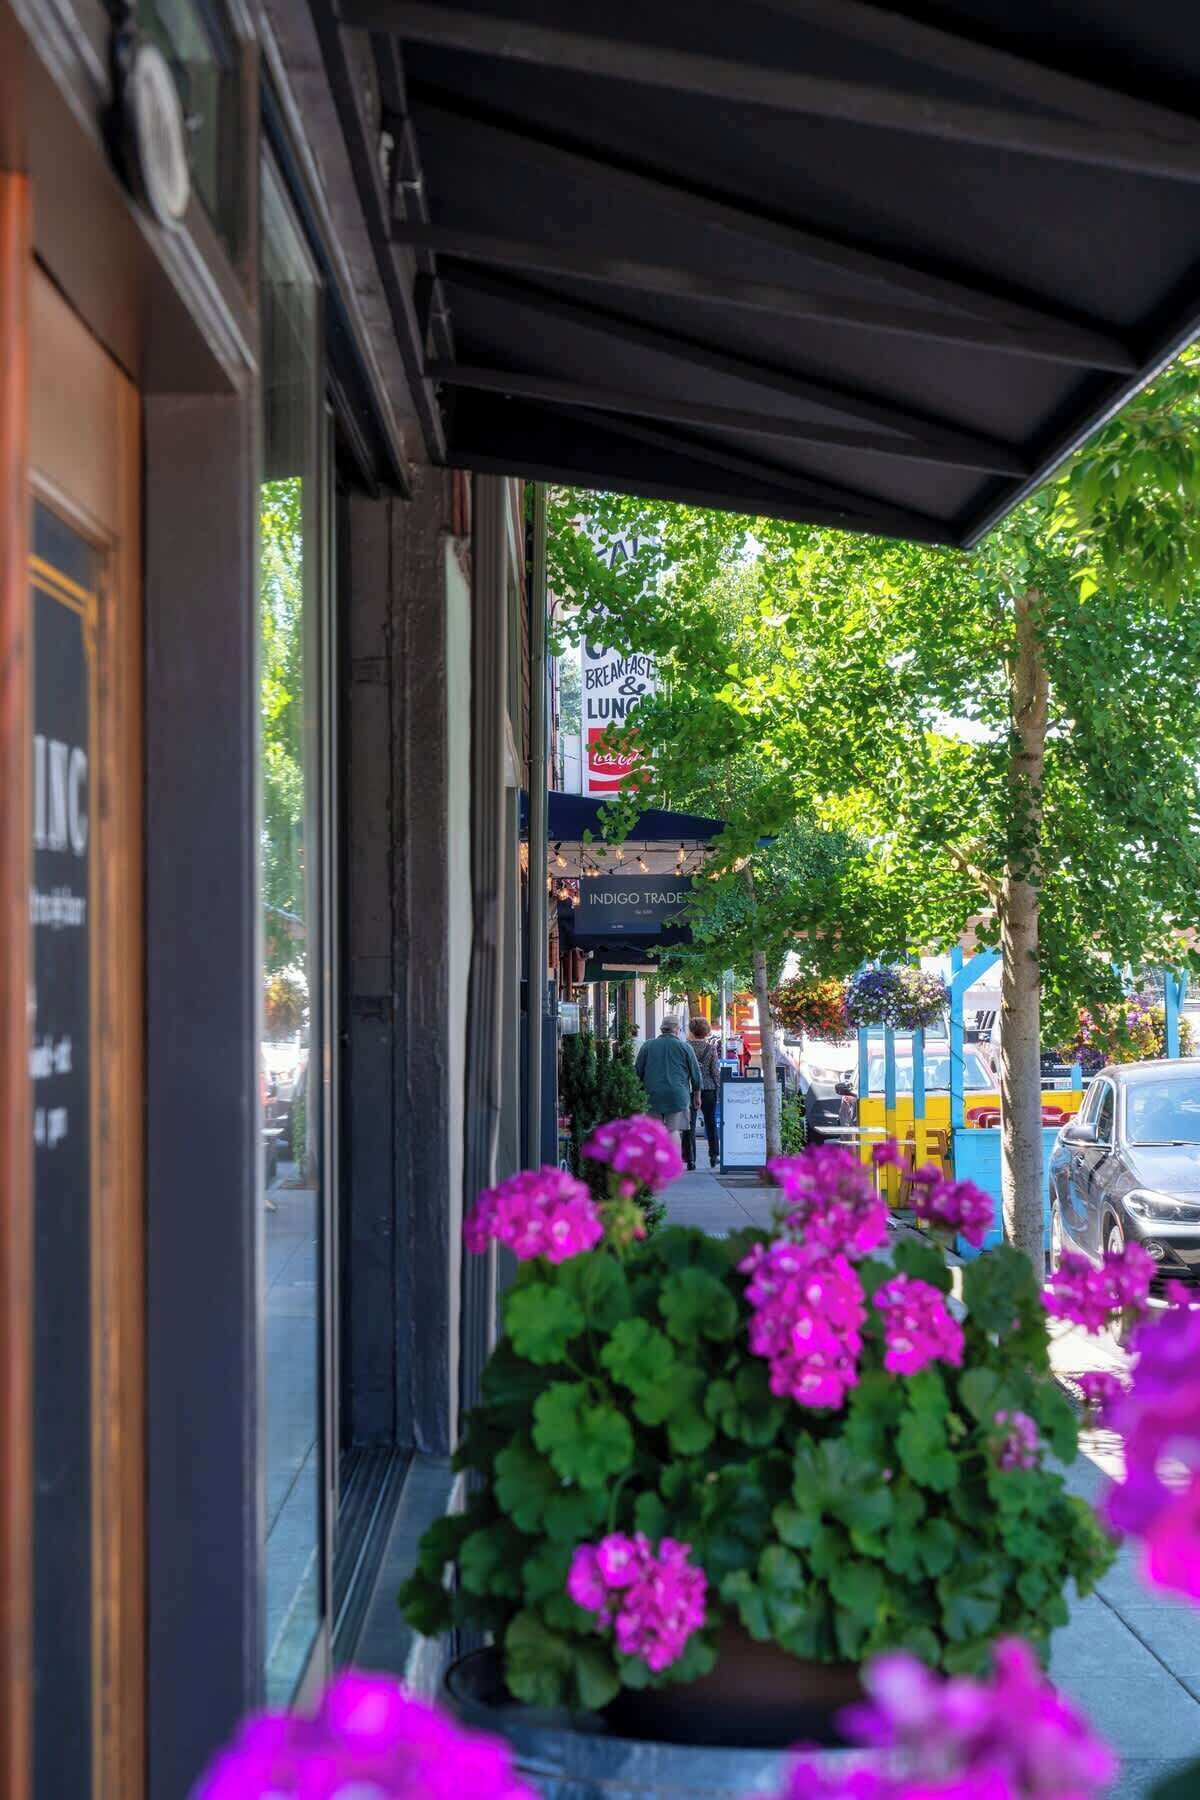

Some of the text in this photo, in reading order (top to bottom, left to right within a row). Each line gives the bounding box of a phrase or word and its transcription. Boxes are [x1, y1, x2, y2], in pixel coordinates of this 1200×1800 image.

[585, 655, 655, 690] BREAKFAST
[618, 676, 646, 696] &
[587, 697, 643, 719] LUNC
[589, 892, 697, 905] INDIGO TRADE
[739, 1112, 764, 1120] PLANT
